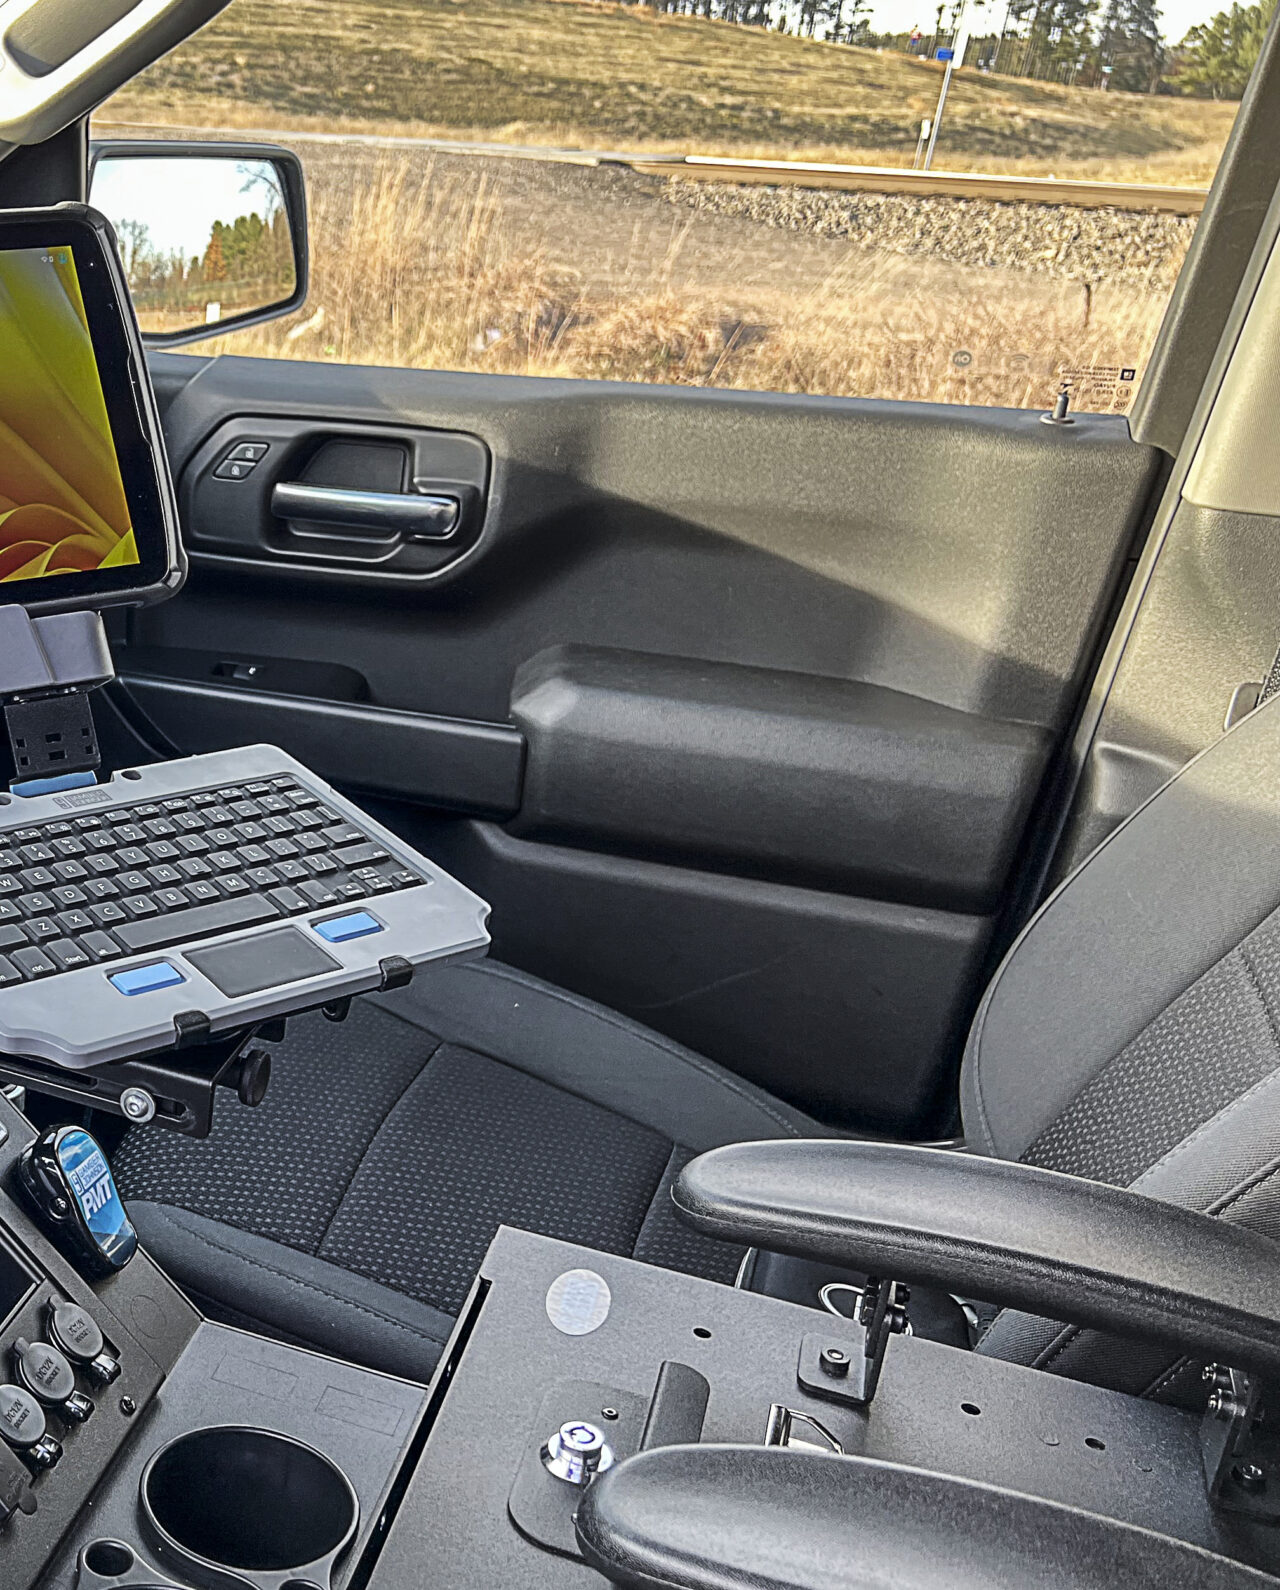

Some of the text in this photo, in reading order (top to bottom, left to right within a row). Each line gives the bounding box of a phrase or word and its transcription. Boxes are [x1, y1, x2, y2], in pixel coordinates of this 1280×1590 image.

[0, 878, 12, 887] W
[33, 872, 44, 880] E
[65, 865, 76, 873] R
[96, 858, 107, 866] T
[0, 905, 10, 913] A
[32, 898, 42, 906] S
[64, 890, 75, 898] D
[97, 883, 106, 891] F
[128, 876, 140, 884] G
[219, 856, 230, 864] K
[38, 922, 49, 931] Z
[70, 915, 82, 923] X
[103, 907, 114, 915] C
[134, 900, 145, 908] V
[166, 893, 177, 901] B
[226, 879, 239, 887] M
[81, 1172, 112, 1221] PMT
